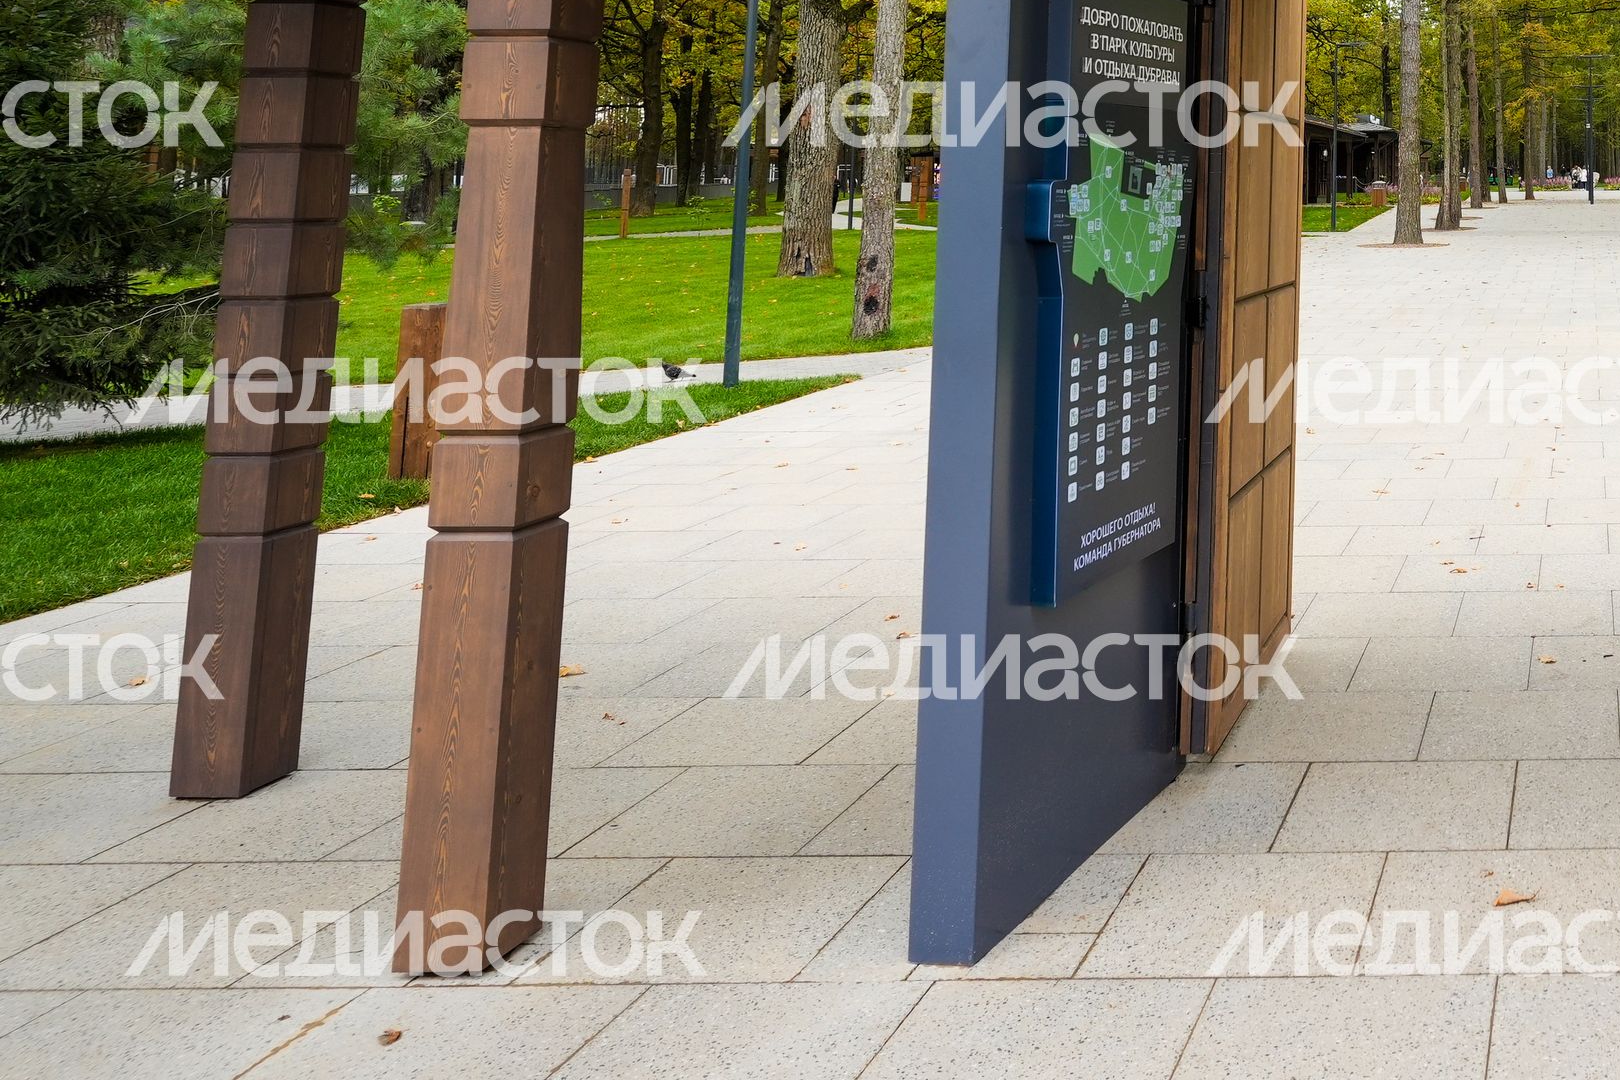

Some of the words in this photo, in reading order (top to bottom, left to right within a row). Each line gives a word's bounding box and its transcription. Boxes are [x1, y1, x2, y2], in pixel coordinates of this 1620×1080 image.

[1080, 6, 1119, 28] ДОБРО
[1120, 14, 1184, 42] ПОЖАЛОВАТЬ
[1090, 33, 1099, 49] В
[1100, 34, 1127, 55] ПАРК
[1129, 40, 1175, 63] КУЛЬТУРЫ
[1082, 56, 1092, 73] И
[1094, 58, 1136, 79] ОТДЫХА
[1136, 65, 1180, 86] ДУБРАВА!
[1081, 517, 1123, 549] ХОРОШЕГО
[1124, 502, 1156, 527] ОТДЫХА!
[1074, 540, 1113, 572] КОМАНДА
[1113, 517, 1161, 552] ГУБЕРНАТОРА
